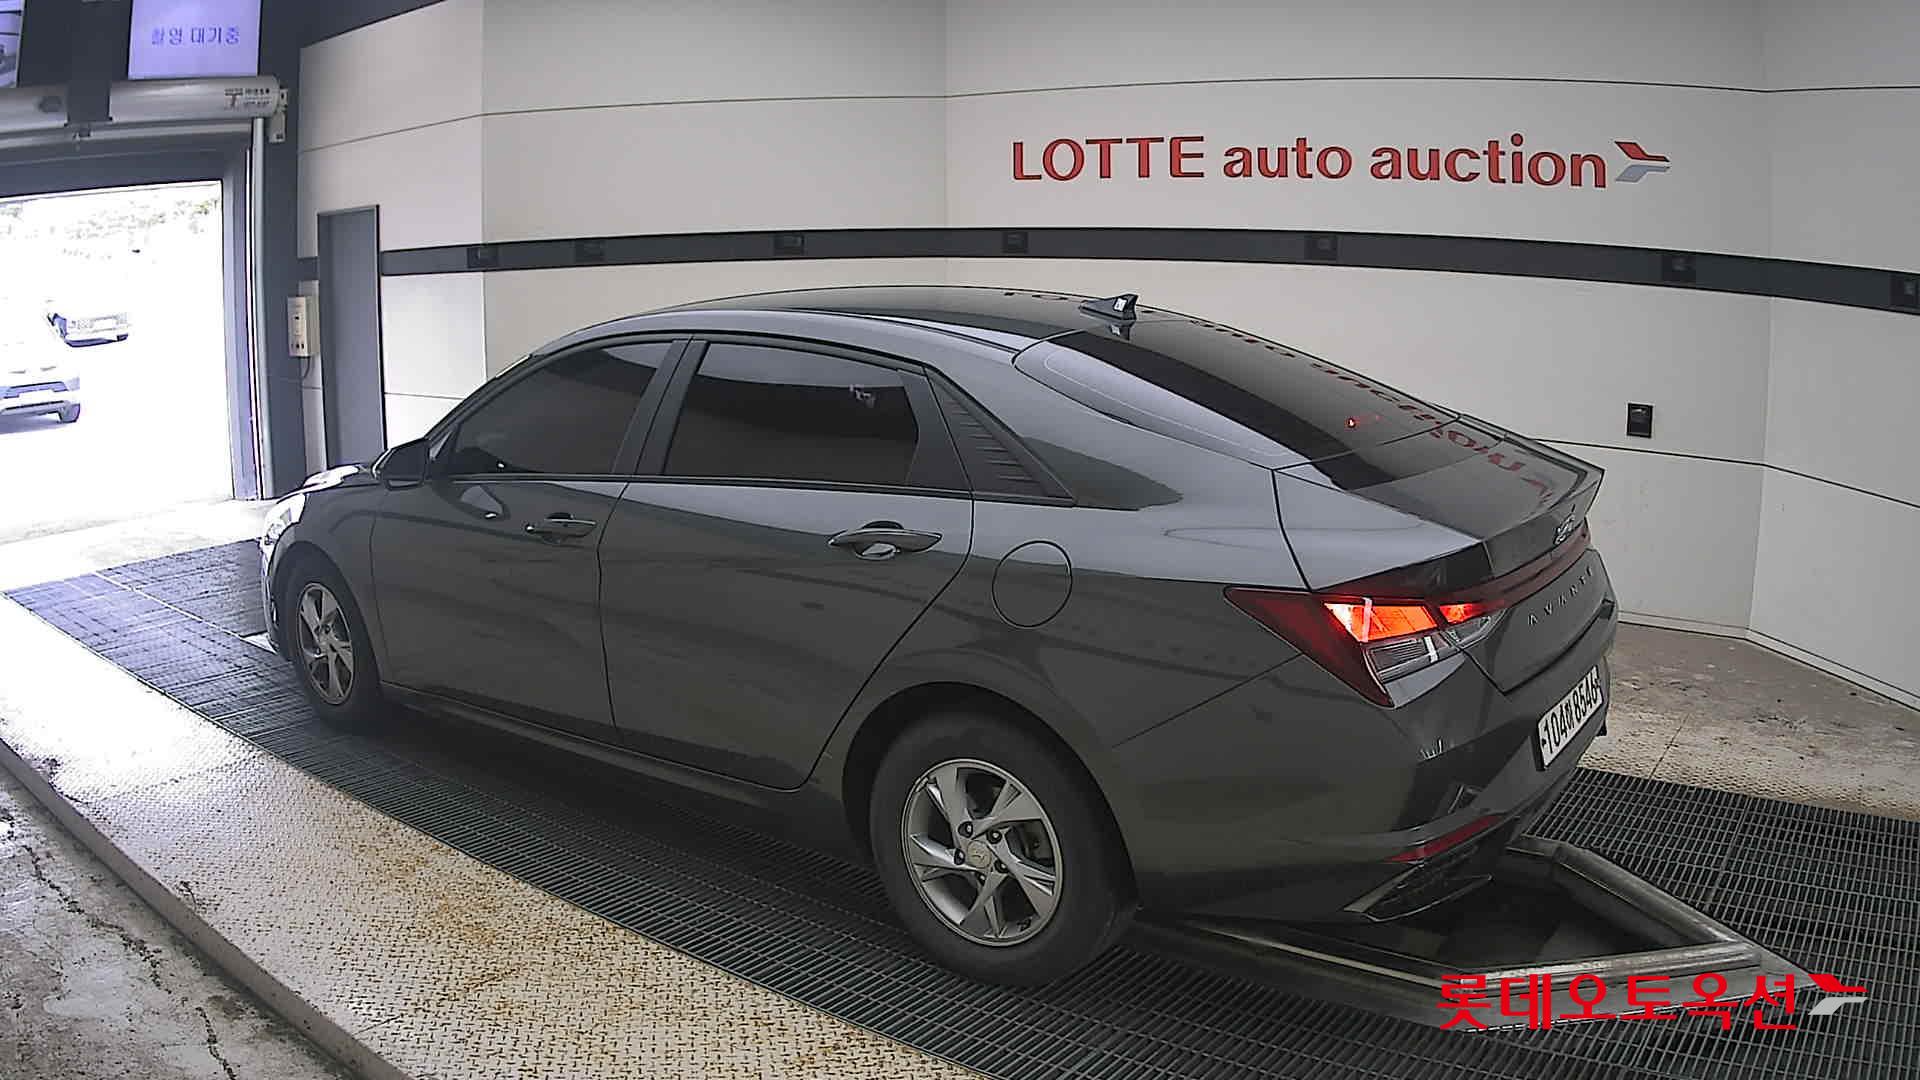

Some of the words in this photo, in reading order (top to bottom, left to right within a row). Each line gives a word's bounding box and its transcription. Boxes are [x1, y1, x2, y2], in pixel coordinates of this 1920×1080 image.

[1013, 136, 1204, 181] LOTTE
[1223, 137, 1352, 179] auto
[1370, 133, 1606, 188] auction
